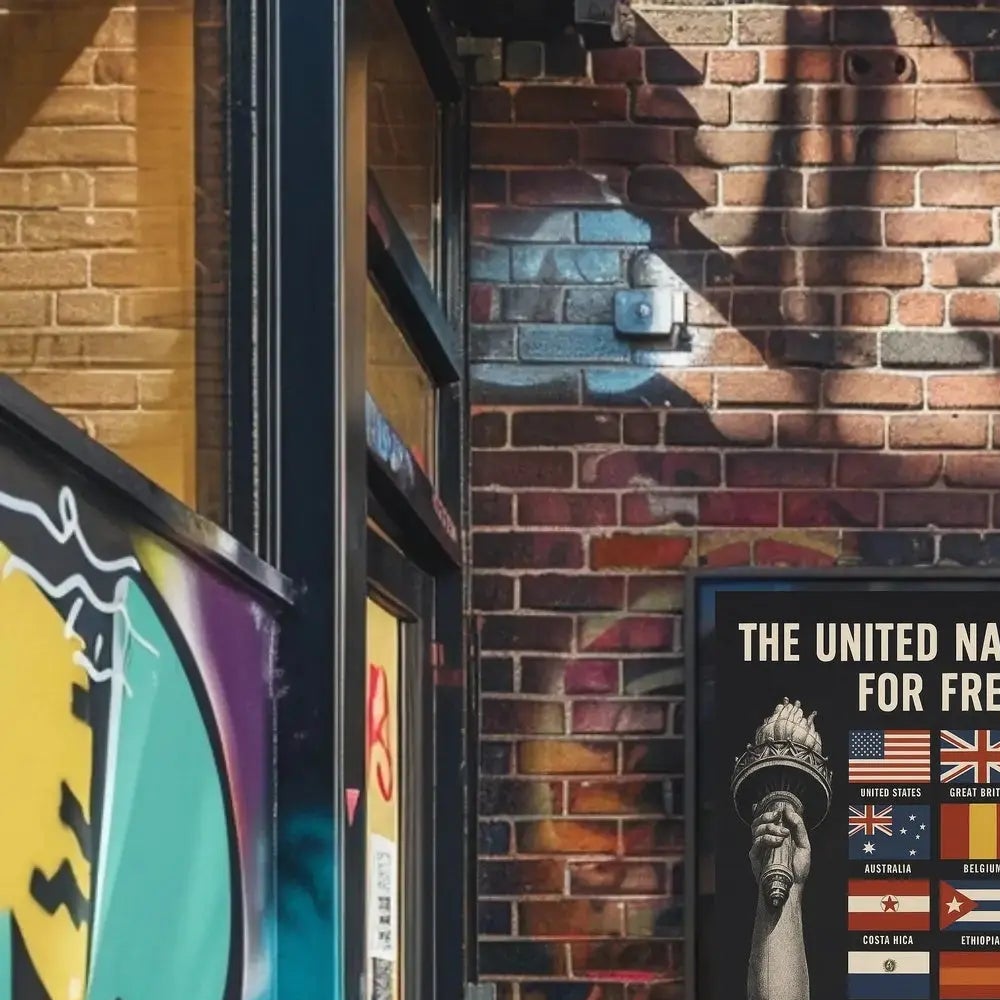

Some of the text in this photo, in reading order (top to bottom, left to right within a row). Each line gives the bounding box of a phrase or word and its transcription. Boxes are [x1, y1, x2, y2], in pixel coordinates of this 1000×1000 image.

[738, 622, 800, 662] THE
[816, 622, 938, 663] UNITED
[858, 672, 924, 712] FOR
[860, 787, 922, 798] UNITED STATES
[949, 787, 978, 798] GREAT
[864, 863, 912, 874] AUSTRALIA
[862, 935, 890, 945] COSTA
[961, 935, 1000, 946] ETHIOPIA
